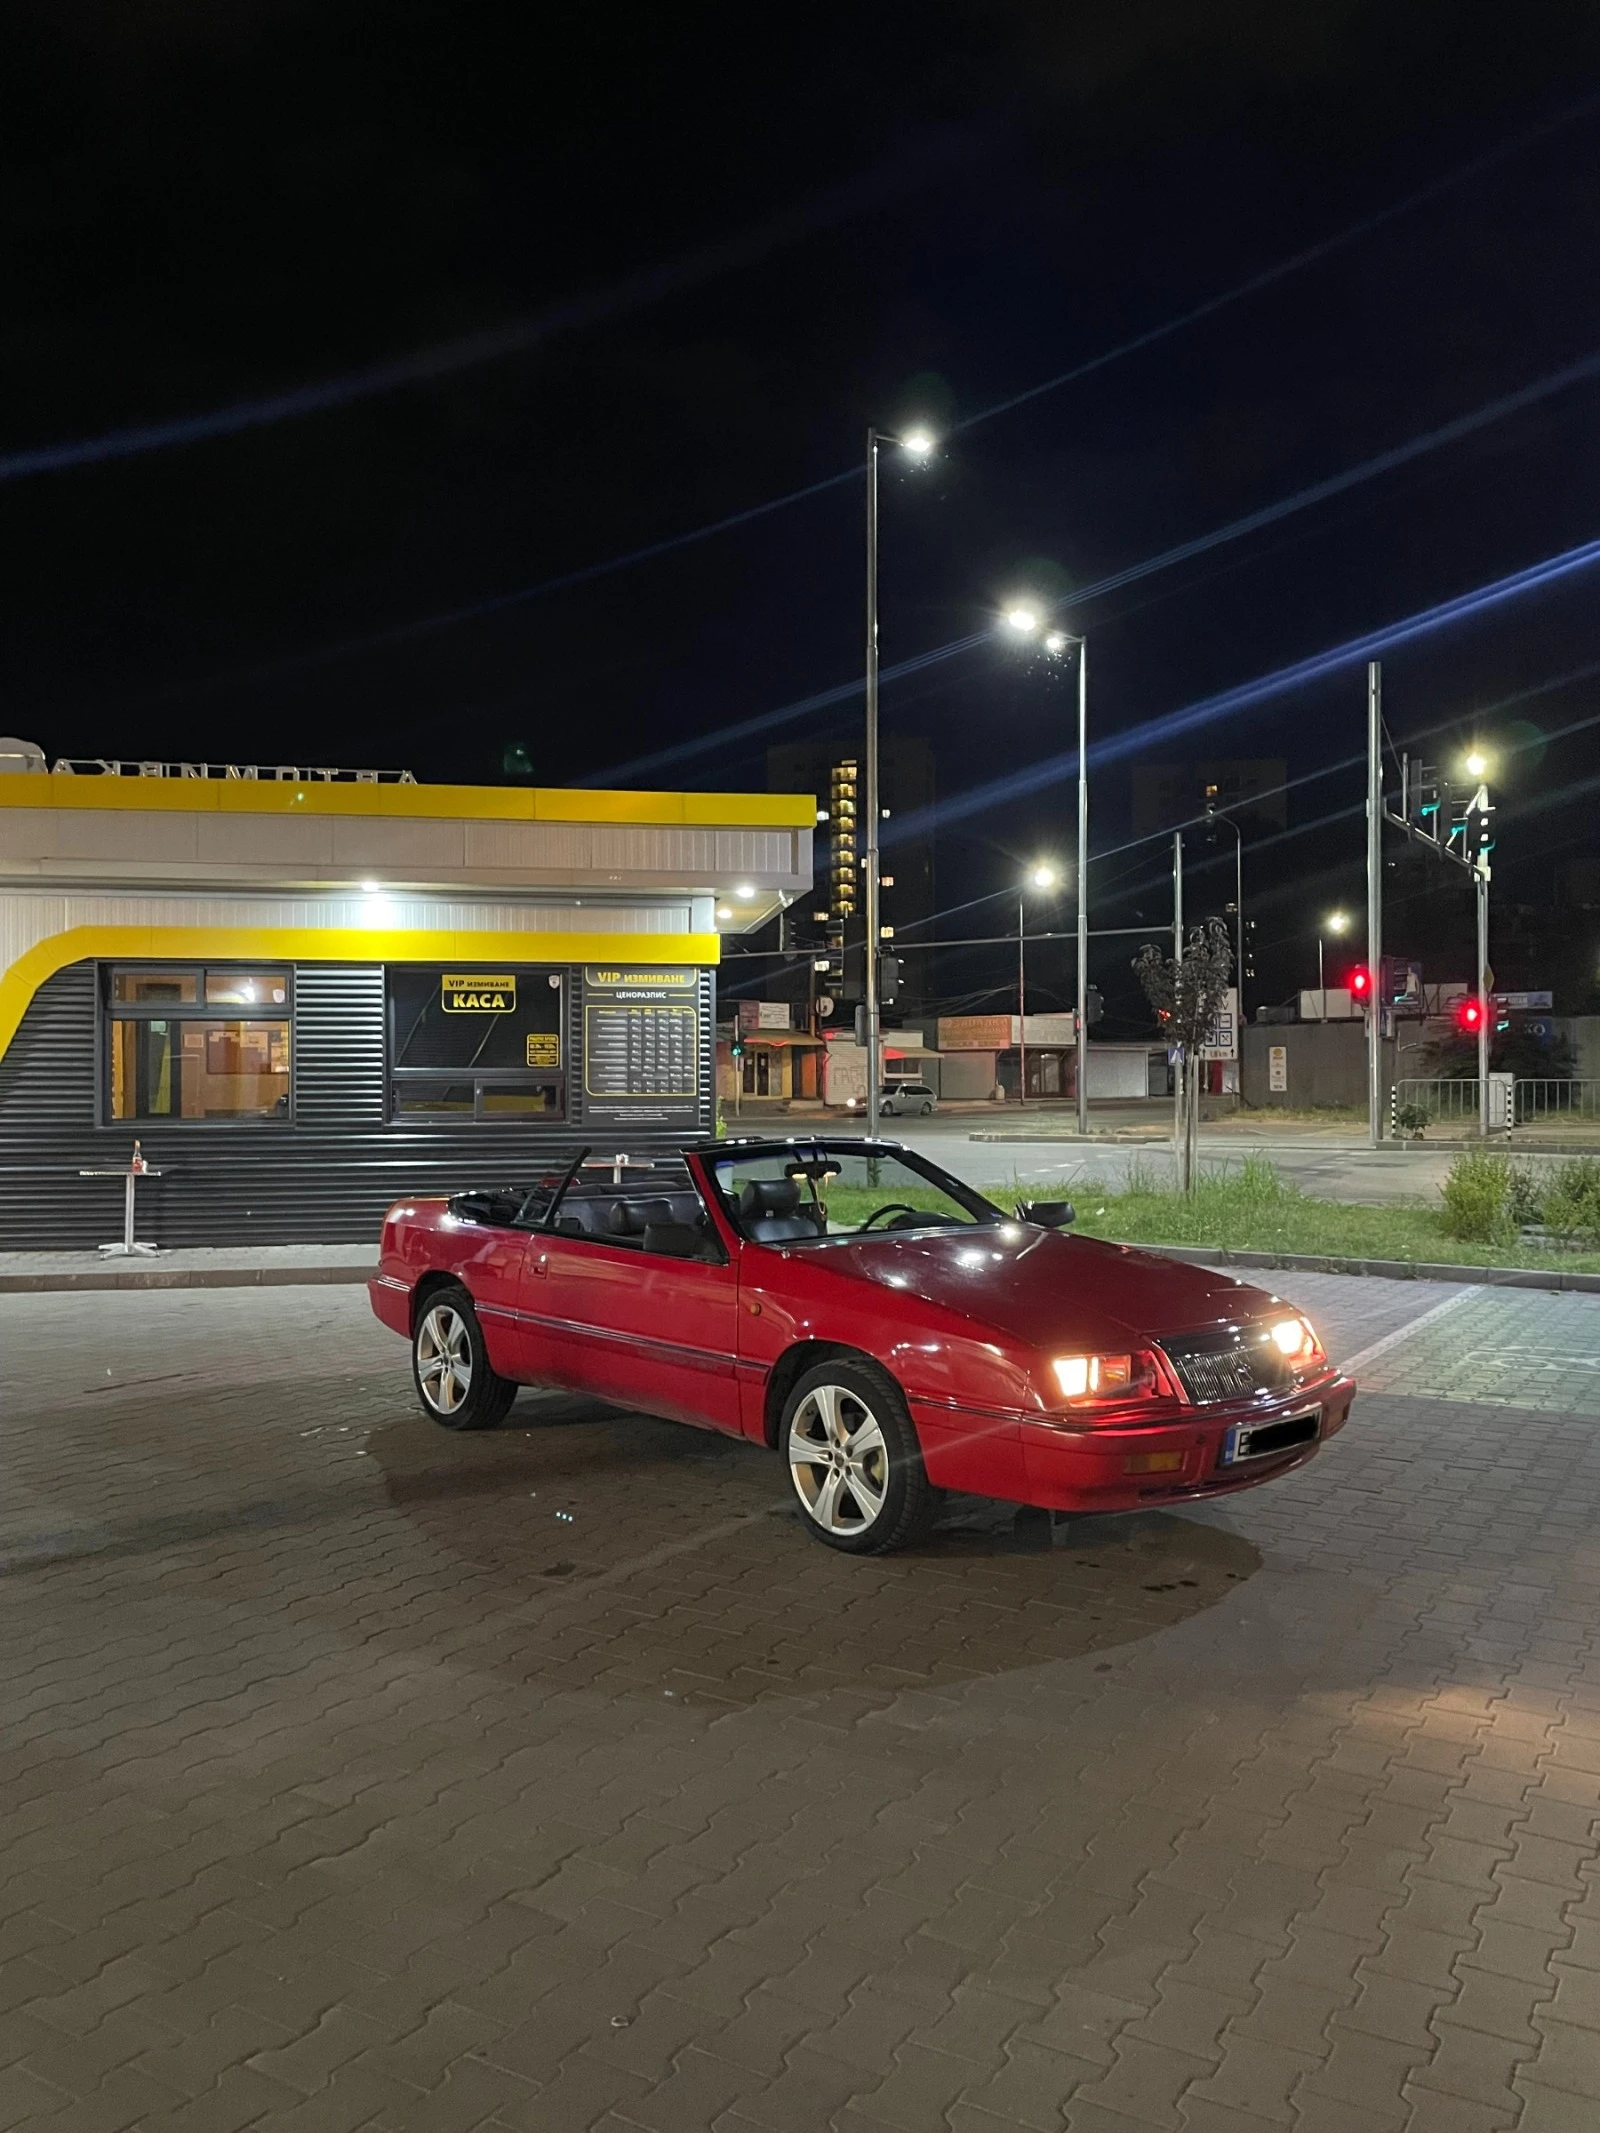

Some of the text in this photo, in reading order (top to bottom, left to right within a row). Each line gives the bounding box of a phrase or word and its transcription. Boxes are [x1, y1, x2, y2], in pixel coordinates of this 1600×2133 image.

[597, 972, 686, 984] VIP ИЗМИВАНЕ
[453, 994, 506, 1008] КАСА
[615, 991, 667, 999] ЦЕНОРАЗПИС
